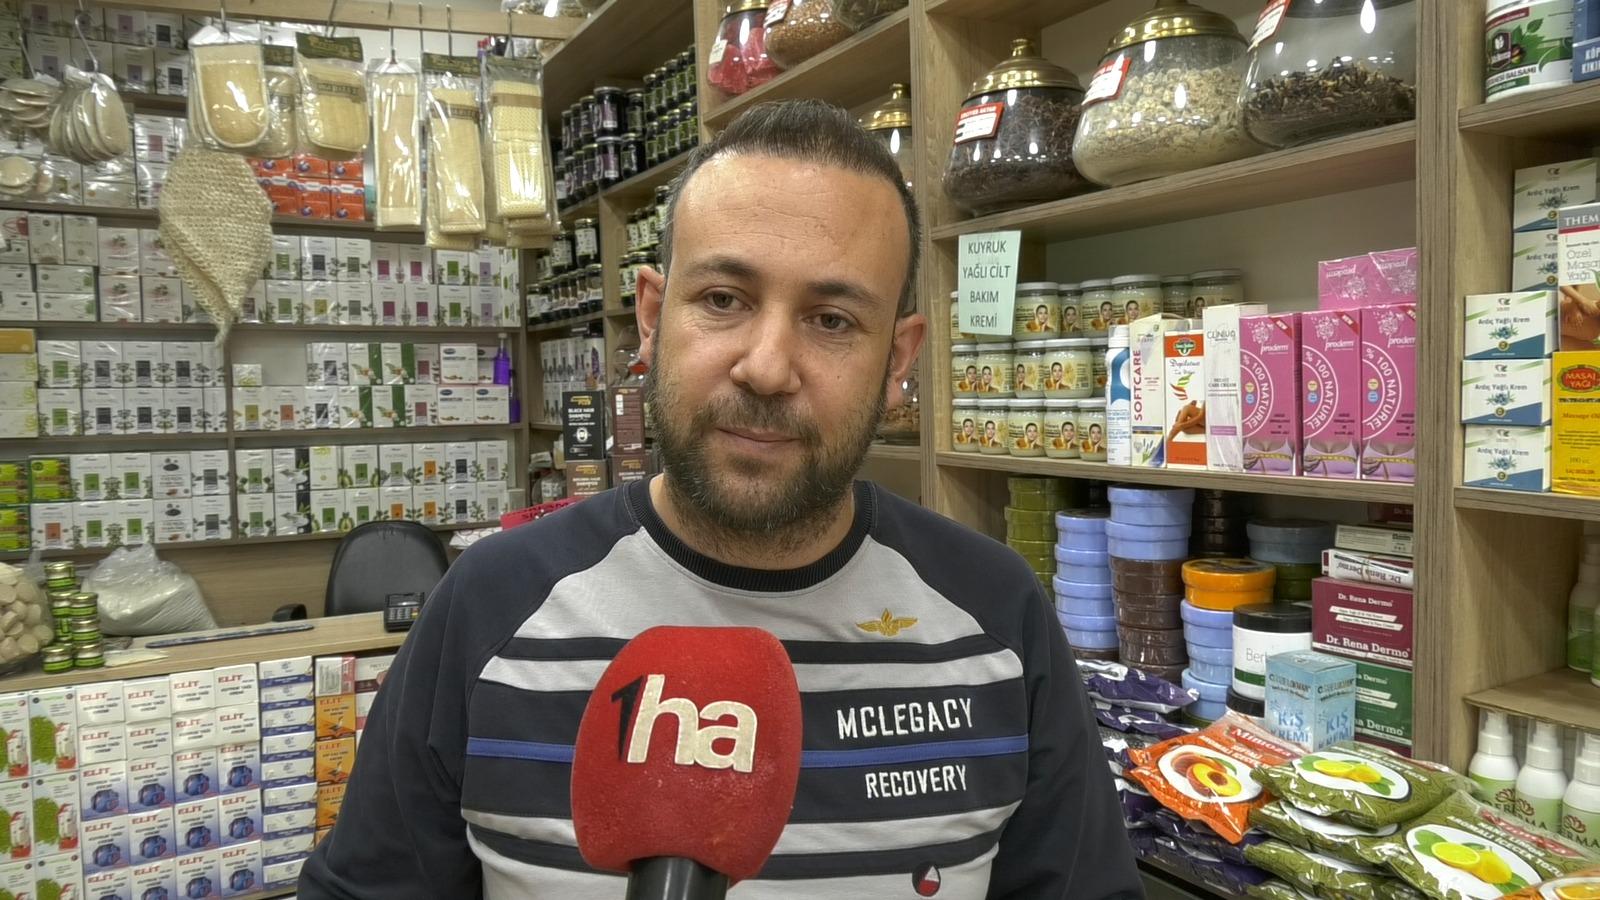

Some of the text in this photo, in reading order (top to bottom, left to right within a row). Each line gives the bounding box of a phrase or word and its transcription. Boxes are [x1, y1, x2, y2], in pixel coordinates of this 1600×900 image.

[968, 240, 1006, 254] KUYRUK
[963, 263, 1011, 278] YAĞLI CİLT
[970, 291, 999, 304] BAKIM
[970, 313, 998, 328] KREMİ
[1251, 362, 1265, 381] 100
[1316, 360, 1330, 379] 100
[1376, 357, 1393, 377] 100
[1133, 350, 1143, 421] SOFTCARE
[1248, 383, 1270, 430] NATUREL
[1307, 380, 1334, 430] NATUREL
[1366, 379, 1396, 430] NATUREL
[1338, 593, 1348, 601] Dr.
[1349, 595, 1366, 603] Rena
[1326, 634, 1409, 658] Dr. Rena Dermo
[837, 698, 972, 739] MCLEGACY
[1367, 719, 1404, 736] Dermo
[1232, 728, 1291, 757] Mimoza
[865, 765, 967, 799] RECOVERY
[1447, 815, 1495, 840] AROMALI
[1535, 860, 1564, 878] TOZU
